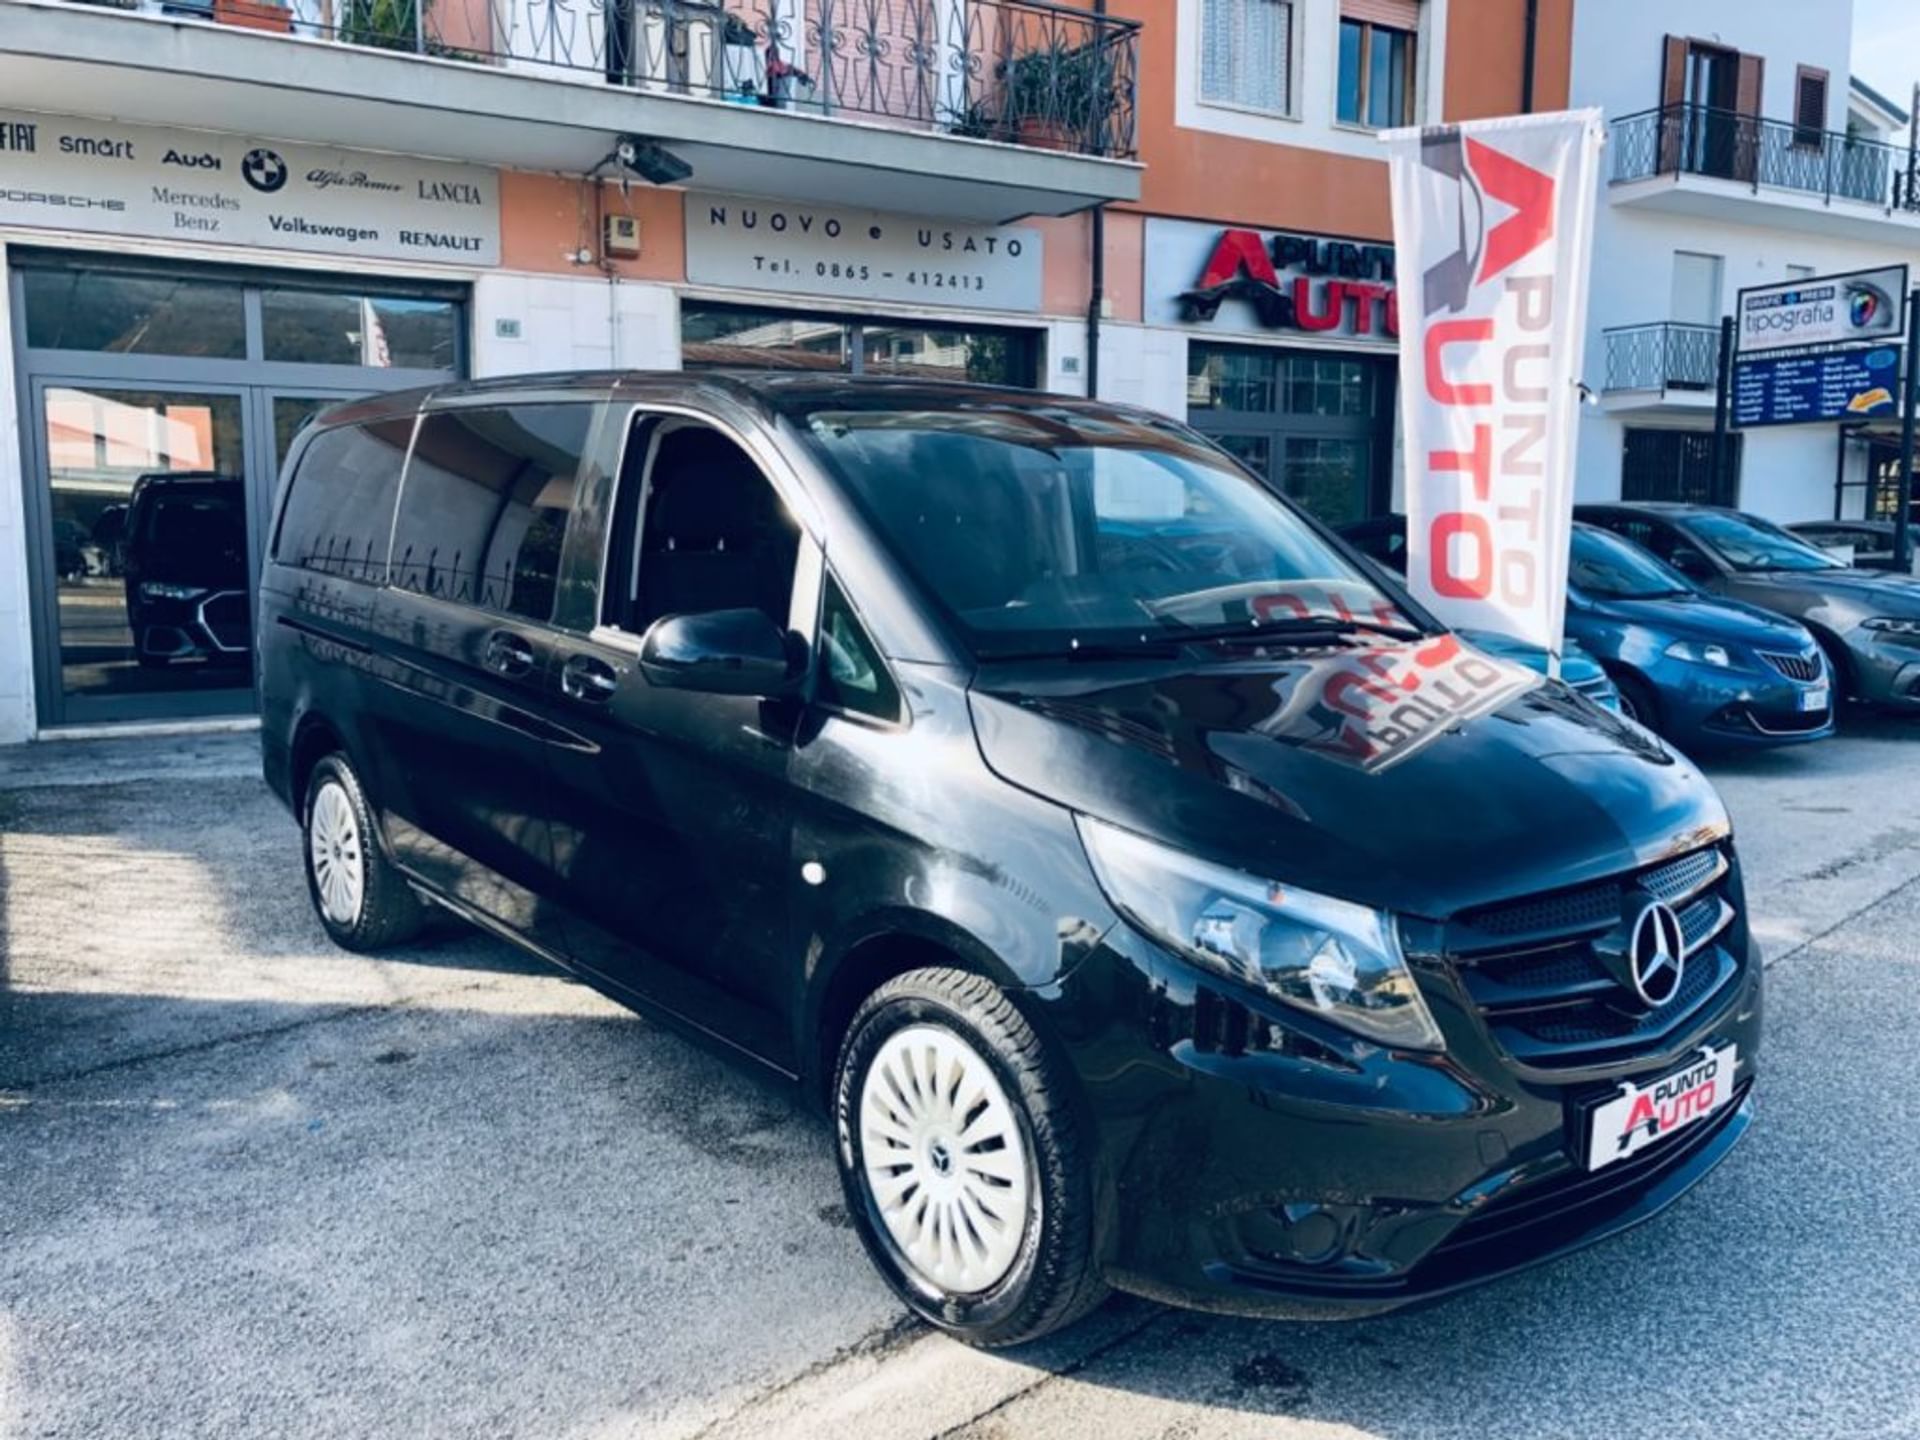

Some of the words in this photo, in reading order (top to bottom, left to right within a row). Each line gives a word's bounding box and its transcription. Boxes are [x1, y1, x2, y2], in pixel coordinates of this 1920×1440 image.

[0, 121, 37, 153] FIAT
[58, 135, 136, 160] smart
[161, 149, 222, 170] Audi
[152, 187, 241, 211] Mercedes
[417, 180, 482, 205] LANCIA
[173, 211, 220, 232] Benz
[268, 214, 379, 241] Volkswagen
[710, 207, 841, 238] NUOVO
[869, 225, 882, 240] e
[918, 229, 1023, 257] USATO
[399, 230, 483, 251] RENAULT
[1272, 235, 1396, 280] PUNT
[753, 256, 801, 274] Tel.
[816, 262, 870, 281] 0865
[906, 270, 985, 290] 412413
[1745, 304, 1834, 334] tipografia
[1499, 275, 1553, 610] PUNTO
[1654, 1059, 1718, 1105] PUNTO
